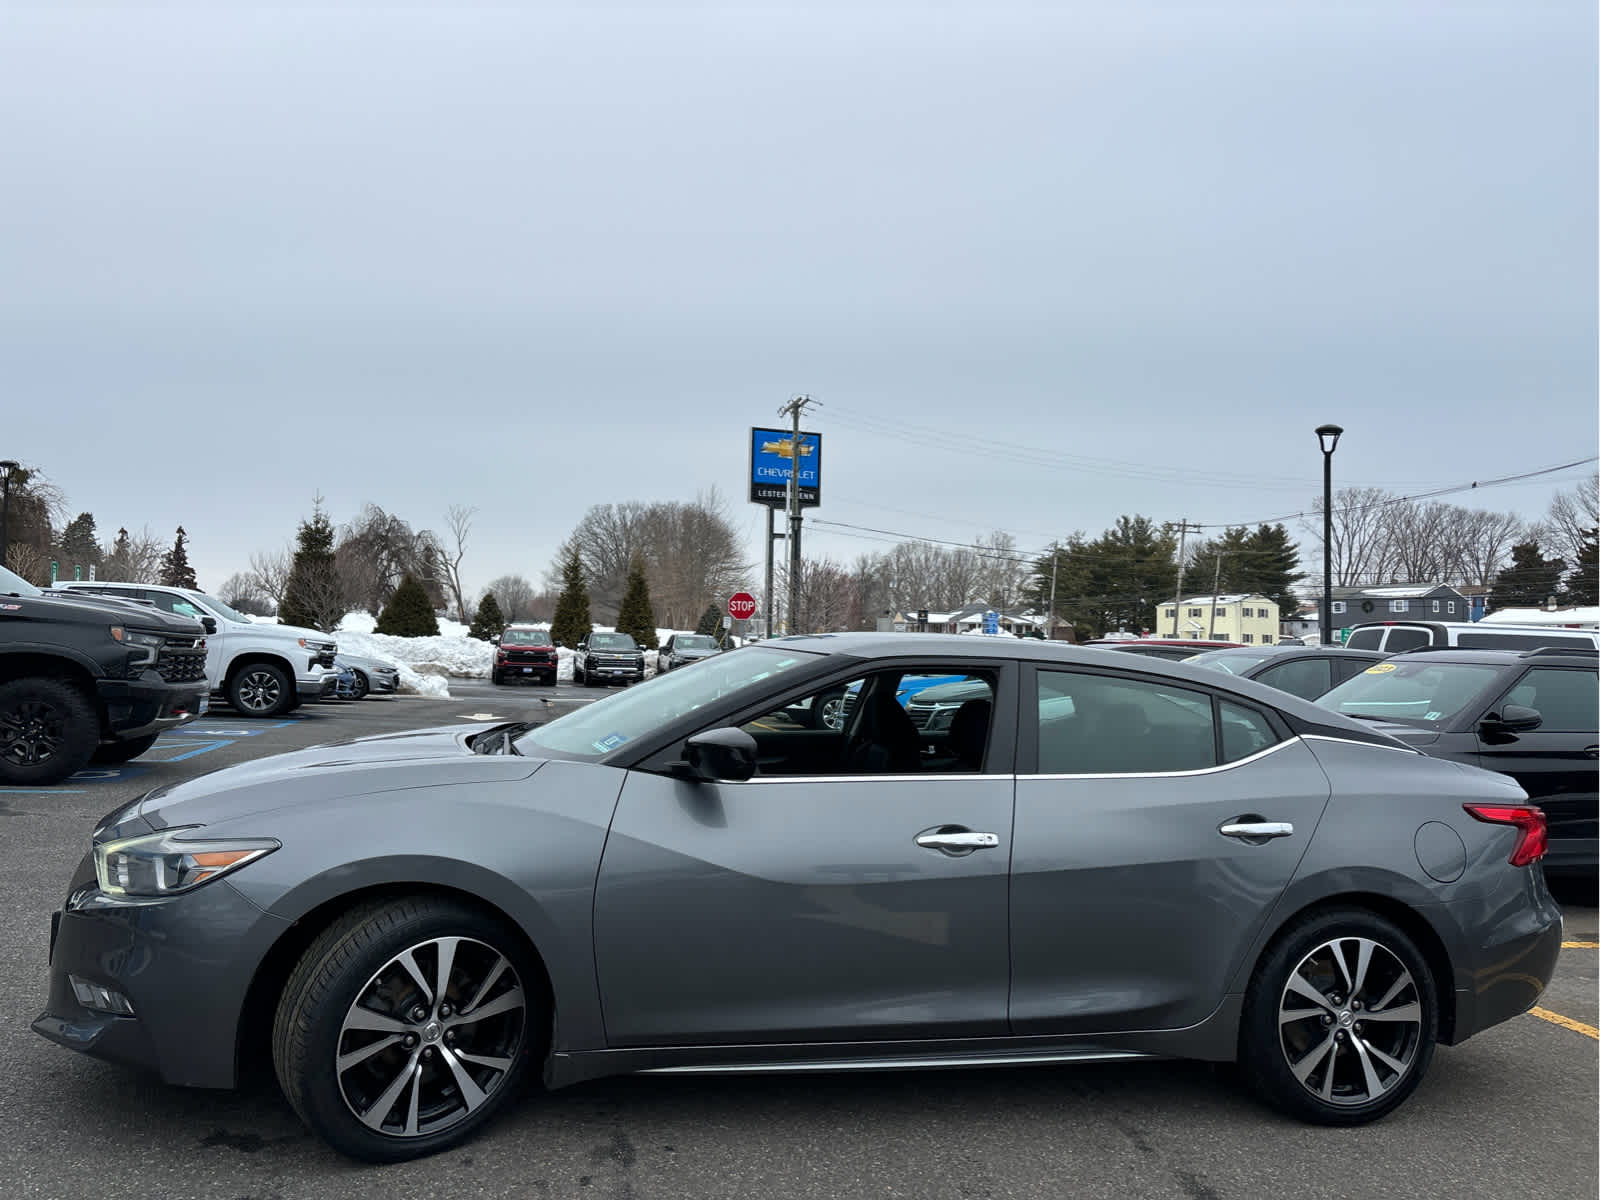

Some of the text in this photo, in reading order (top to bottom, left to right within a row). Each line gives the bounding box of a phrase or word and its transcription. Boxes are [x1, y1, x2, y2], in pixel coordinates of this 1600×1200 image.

[758, 467, 815, 479] CHEVRLET
[790, 492, 815, 500] ENN
[730, 600, 754, 611] STOP
